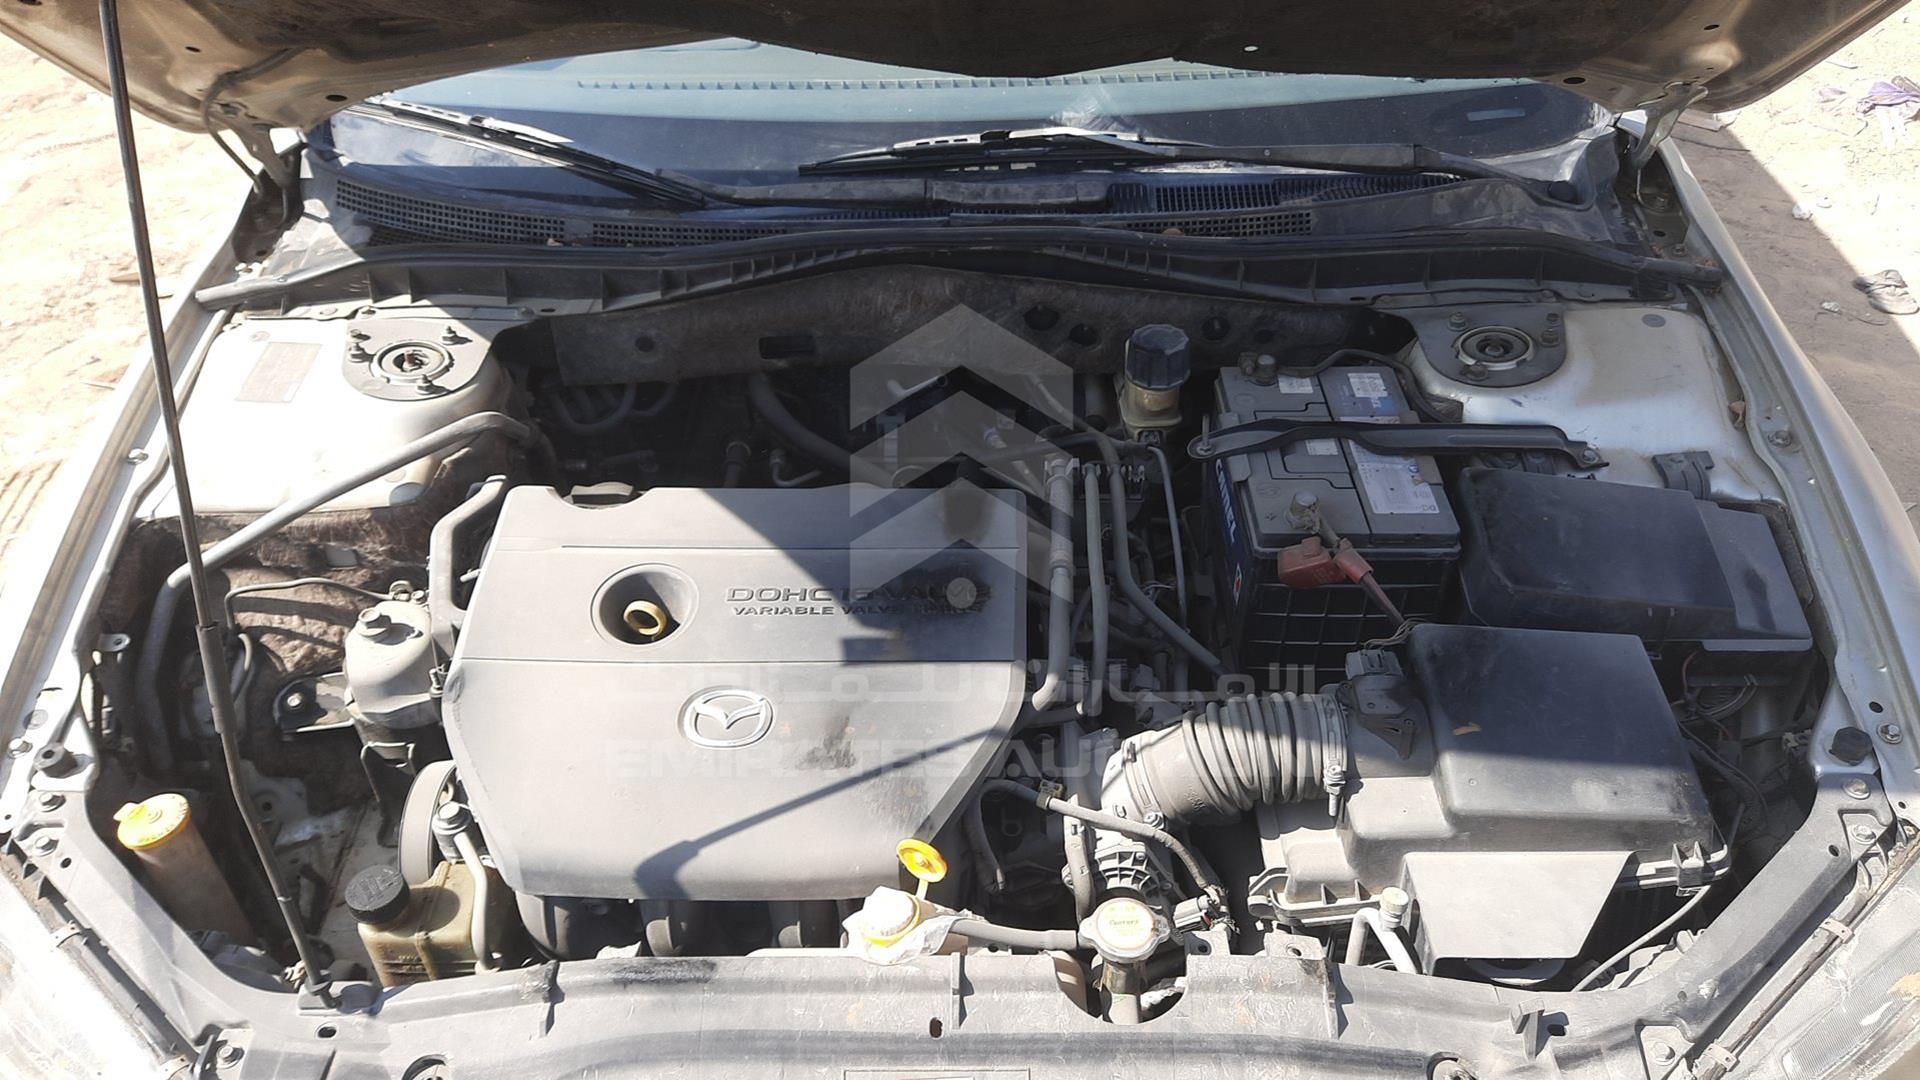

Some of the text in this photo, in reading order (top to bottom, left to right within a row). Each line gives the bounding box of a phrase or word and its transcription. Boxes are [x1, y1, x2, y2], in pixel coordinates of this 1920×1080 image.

[726, 587, 833, 602] DOHC
[734, 605, 835, 615] VARIABLE
[841, 605, 899, 615] VALVE
